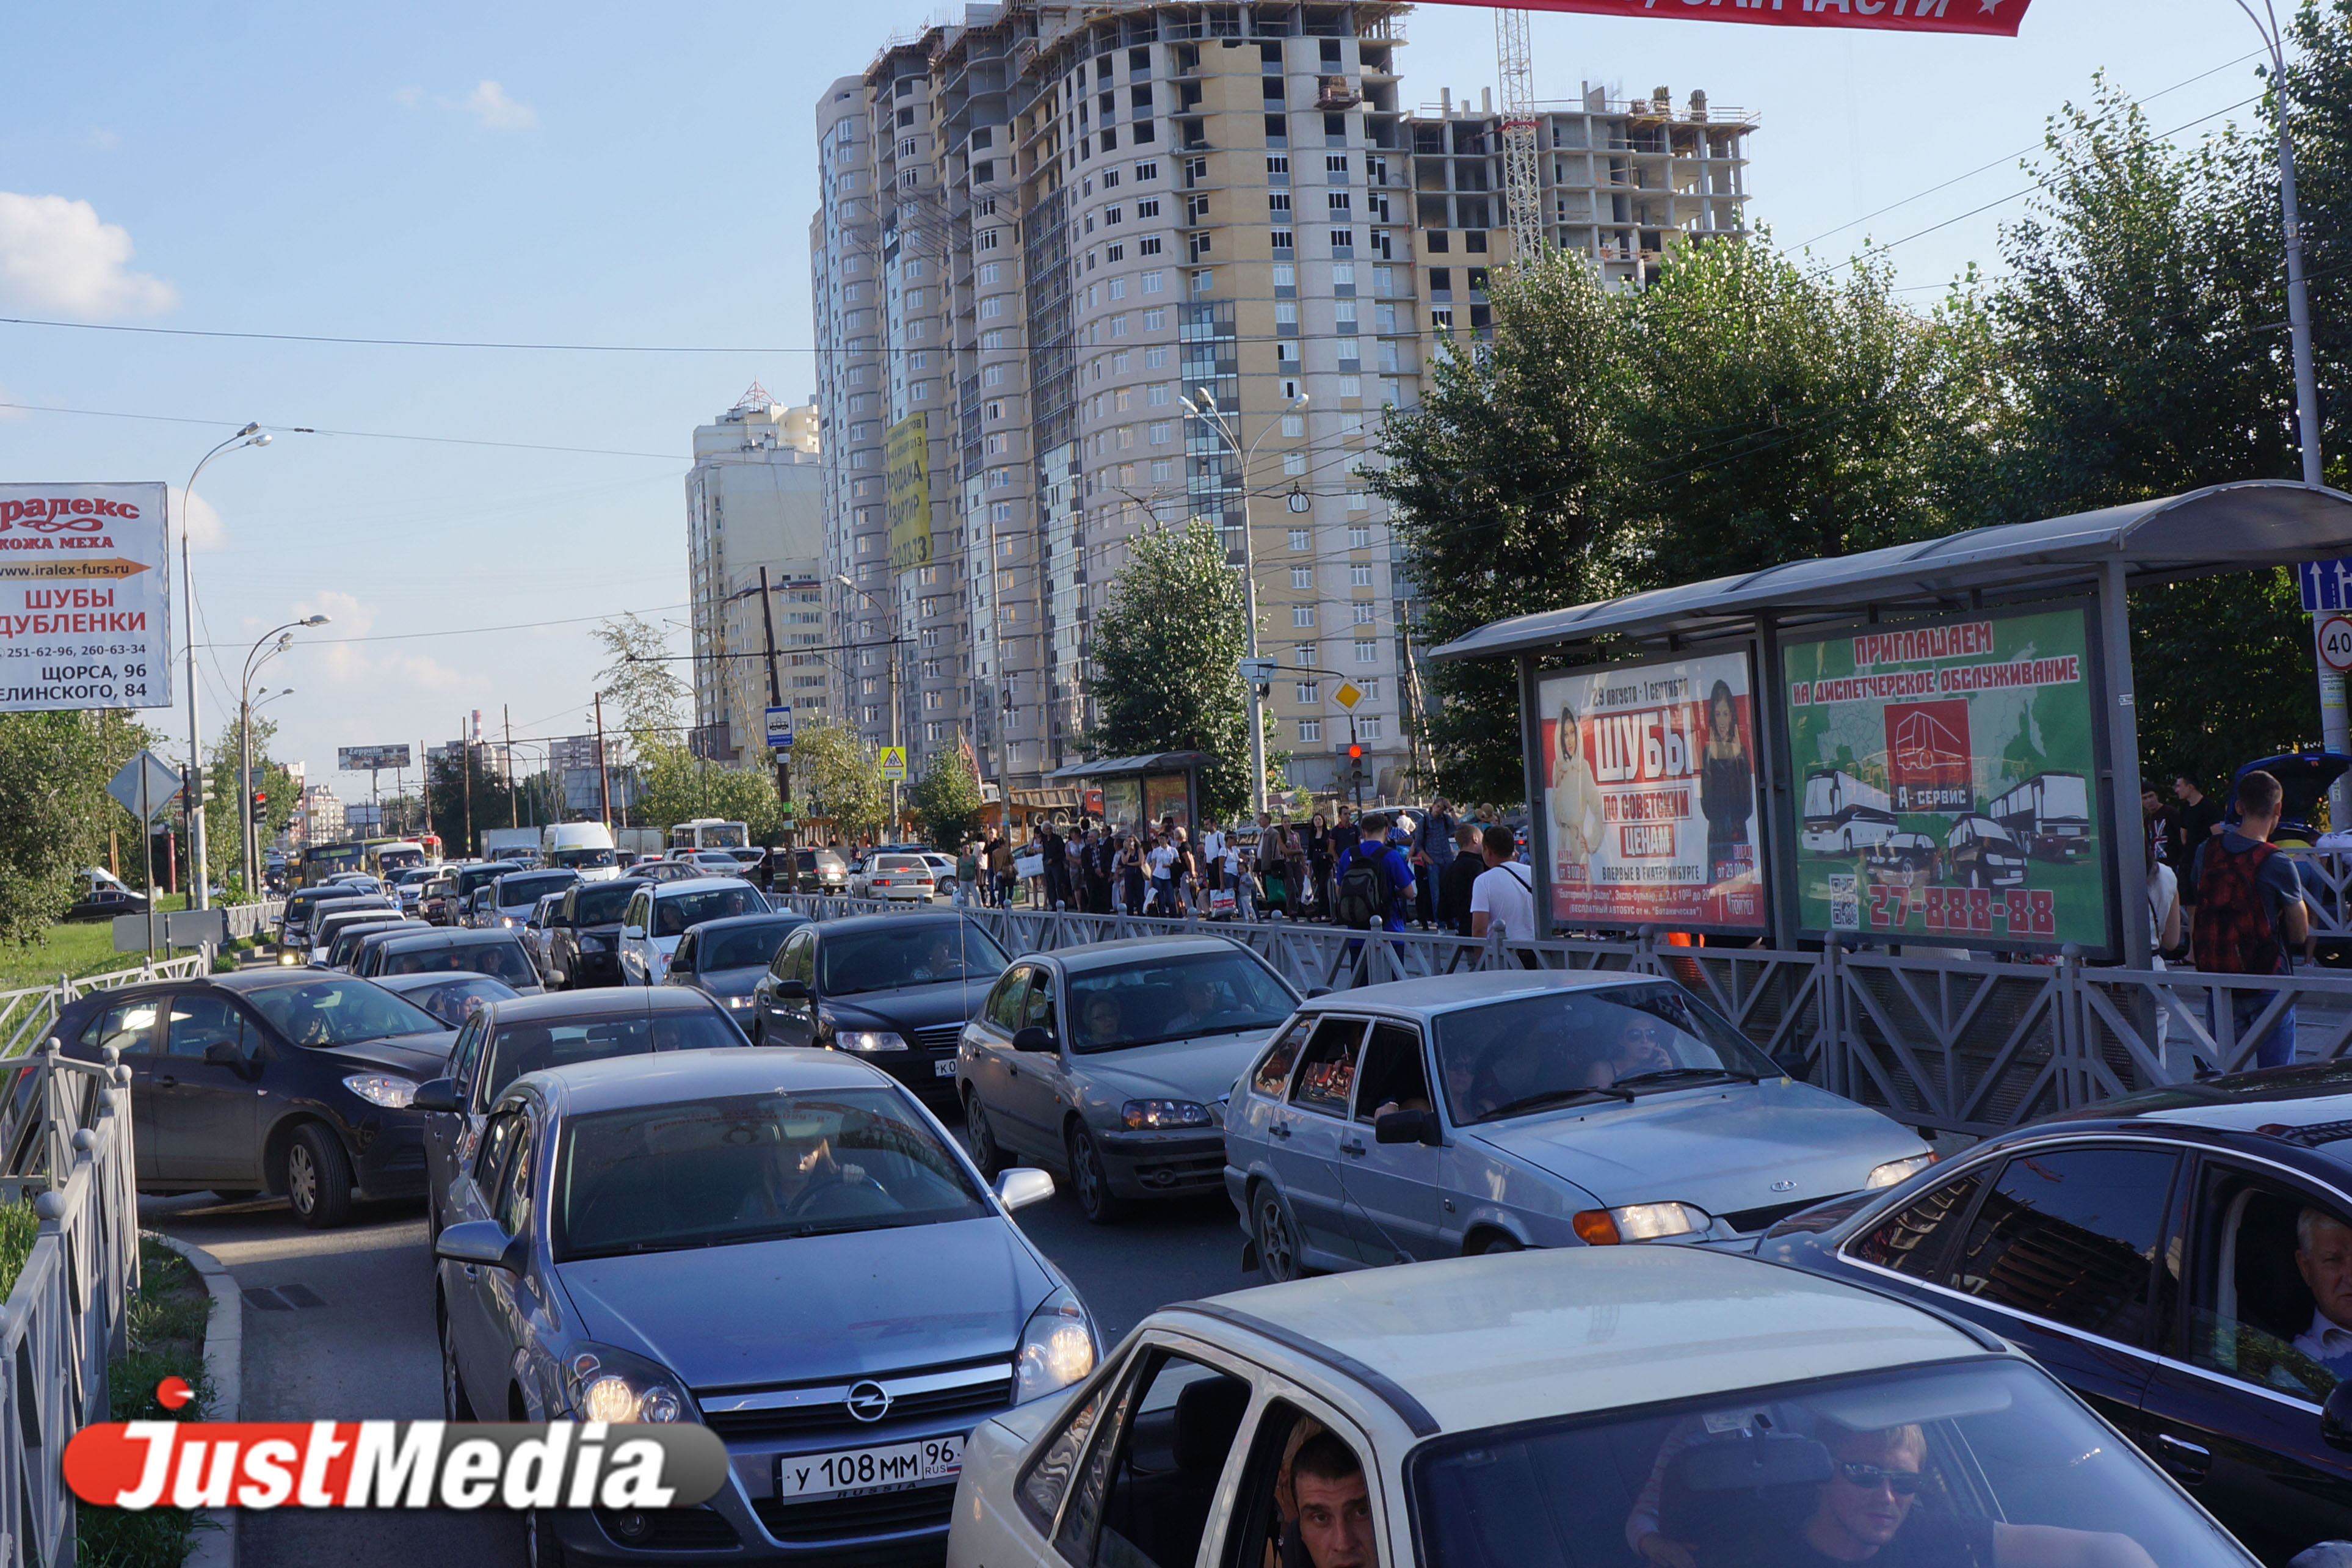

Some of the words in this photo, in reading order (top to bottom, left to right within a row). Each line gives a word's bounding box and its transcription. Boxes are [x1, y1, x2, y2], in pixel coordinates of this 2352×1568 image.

[890, 459, 923, 495] РОДАЖА
[59, 536, 115, 549] МЕХА
[25, 588, 114, 609] ШУБЫ
[7, 647, 76, 658] 251-62-96,
[81, 644, 146, 656] 260-63-34
[1854, 623, 1994, 665] ПРИГЛАШАЕМ
[2328, 633, 2351, 654] 40
[42, 665, 118, 683] ЩОРСА,
[124, 664, 147, 678] 96
[1793, 681, 1810, 705] НА
[1814, 672, 1936, 703] ДИСПЕТЧЕРСКОЕ
[1940, 656, 2079, 692] ОБСЛУЖИВАНИЕ
[125, 683, 147, 697] 84
[1592, 686, 1604, 707] 29
[1606, 686, 1638, 706] АВГУСТА
[1644, 681, 1648, 702] 1
[1650, 678, 1689, 700] СЕНТЯБРЯ
[348, 747, 383, 757] Zeppelin
[1593, 706, 1694, 782] ШУБЫ
[1603, 795, 1619, 821] ПО
[1622, 790, 1690, 820] СОВЕТСКИМ
[1625, 826, 1671, 855] ЦЕНАМ
[1602, 866, 1634, 881] ВПЕРВЫЕ
[1636, 866, 1641, 880] В
[1642, 865, 1699, 881] ЕКАТЕРИНБУРГЕ
[1718, 866, 1724, 878] от
[1609, 906, 1635, 915] АВТОБУС
[1868, 885, 2055, 934] 27-888-88
[925, 1441, 954, 1465] 96
[925, 1465, 946, 1475] RUS
